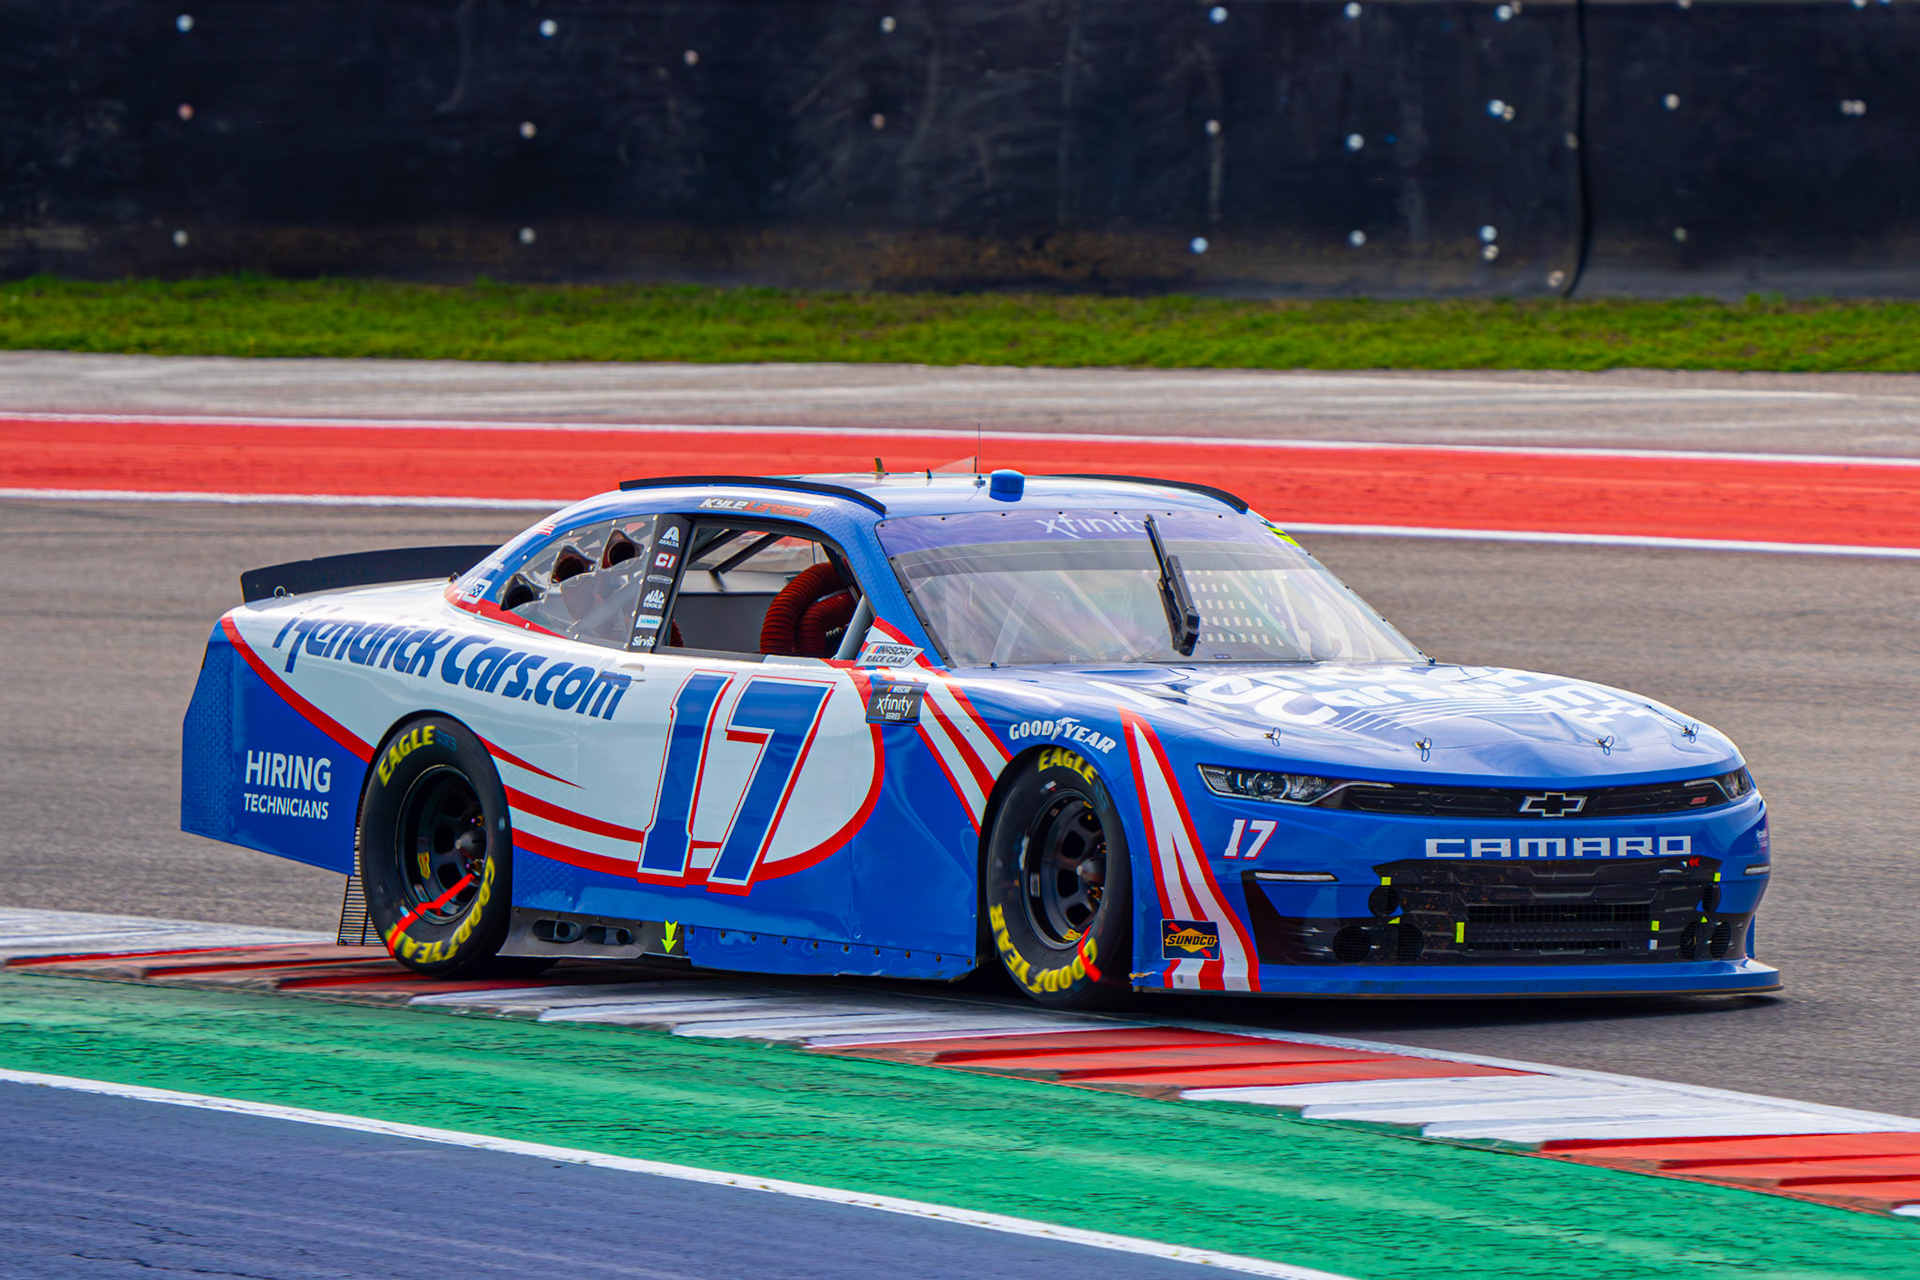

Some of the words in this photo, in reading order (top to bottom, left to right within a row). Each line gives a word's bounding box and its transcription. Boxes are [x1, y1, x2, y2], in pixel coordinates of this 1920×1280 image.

[864, 655, 886, 663] RACE
[886, 656, 905, 664] CAR
[879, 645, 913, 656] NASCAR
[876, 693, 914, 717] xfinity
[378, 724, 436, 787] EAGLE
[1038, 747, 1098, 785] EAGLE
[244, 749, 332, 794] HIRING
[637, 669, 837, 896] 17
[243, 792, 330, 821] TECHNICIANS
[1222, 818, 1279, 860] 17
[1425, 835, 1692, 858] CAMARO
[1166, 934, 1217, 947] SUNOCO
